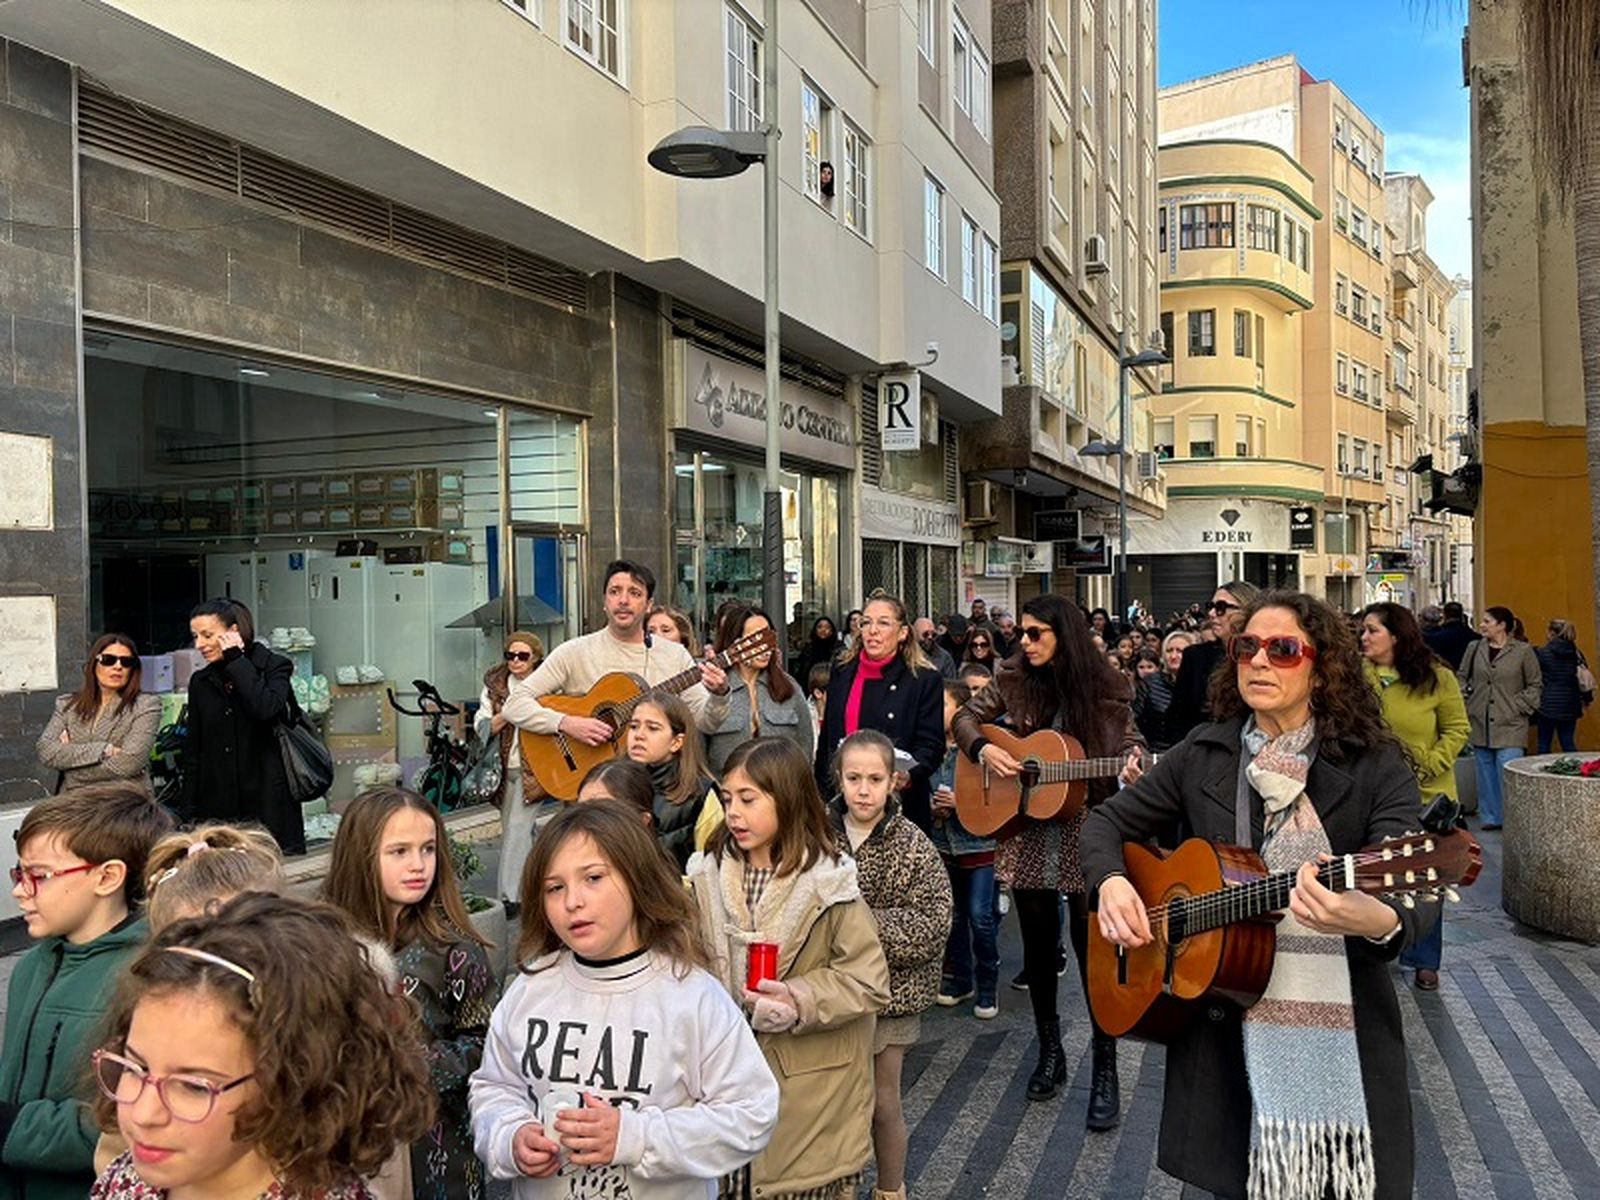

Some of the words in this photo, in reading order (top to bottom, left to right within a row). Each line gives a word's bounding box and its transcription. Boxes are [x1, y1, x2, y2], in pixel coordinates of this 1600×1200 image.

[884, 381, 915, 428] R
[1202, 530, 1253, 543] EDERY
[521, 1018, 653, 1095] REAL
